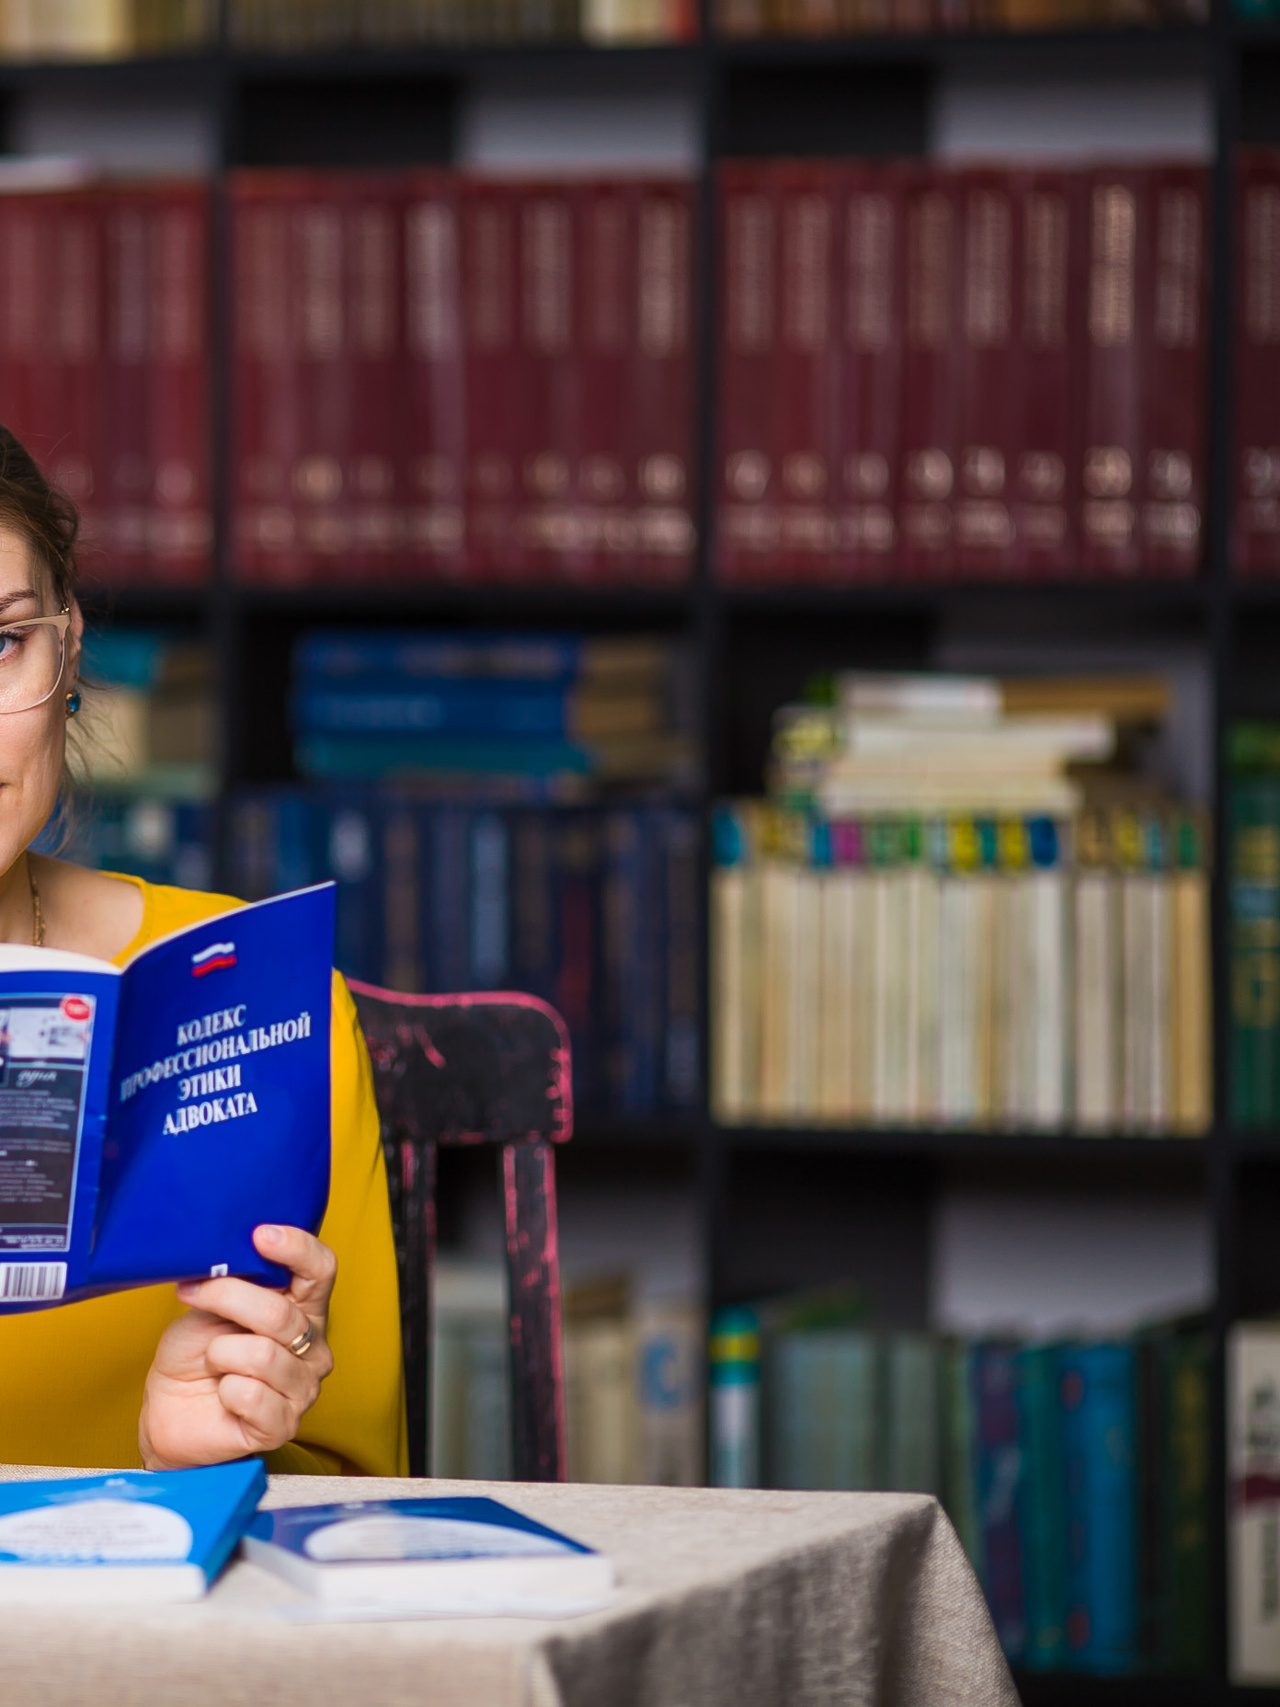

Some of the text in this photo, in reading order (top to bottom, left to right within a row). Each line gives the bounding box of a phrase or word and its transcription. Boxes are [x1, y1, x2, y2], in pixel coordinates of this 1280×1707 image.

[177, 1004, 247, 1046] КОДЕКС
[120, 1011, 311, 1102] ПРОФЕССИОНАЛЬНОЙ
[178, 1064, 241, 1101] ЭТИКИ
[162, 1092, 258, 1136] АДВОКАТА
